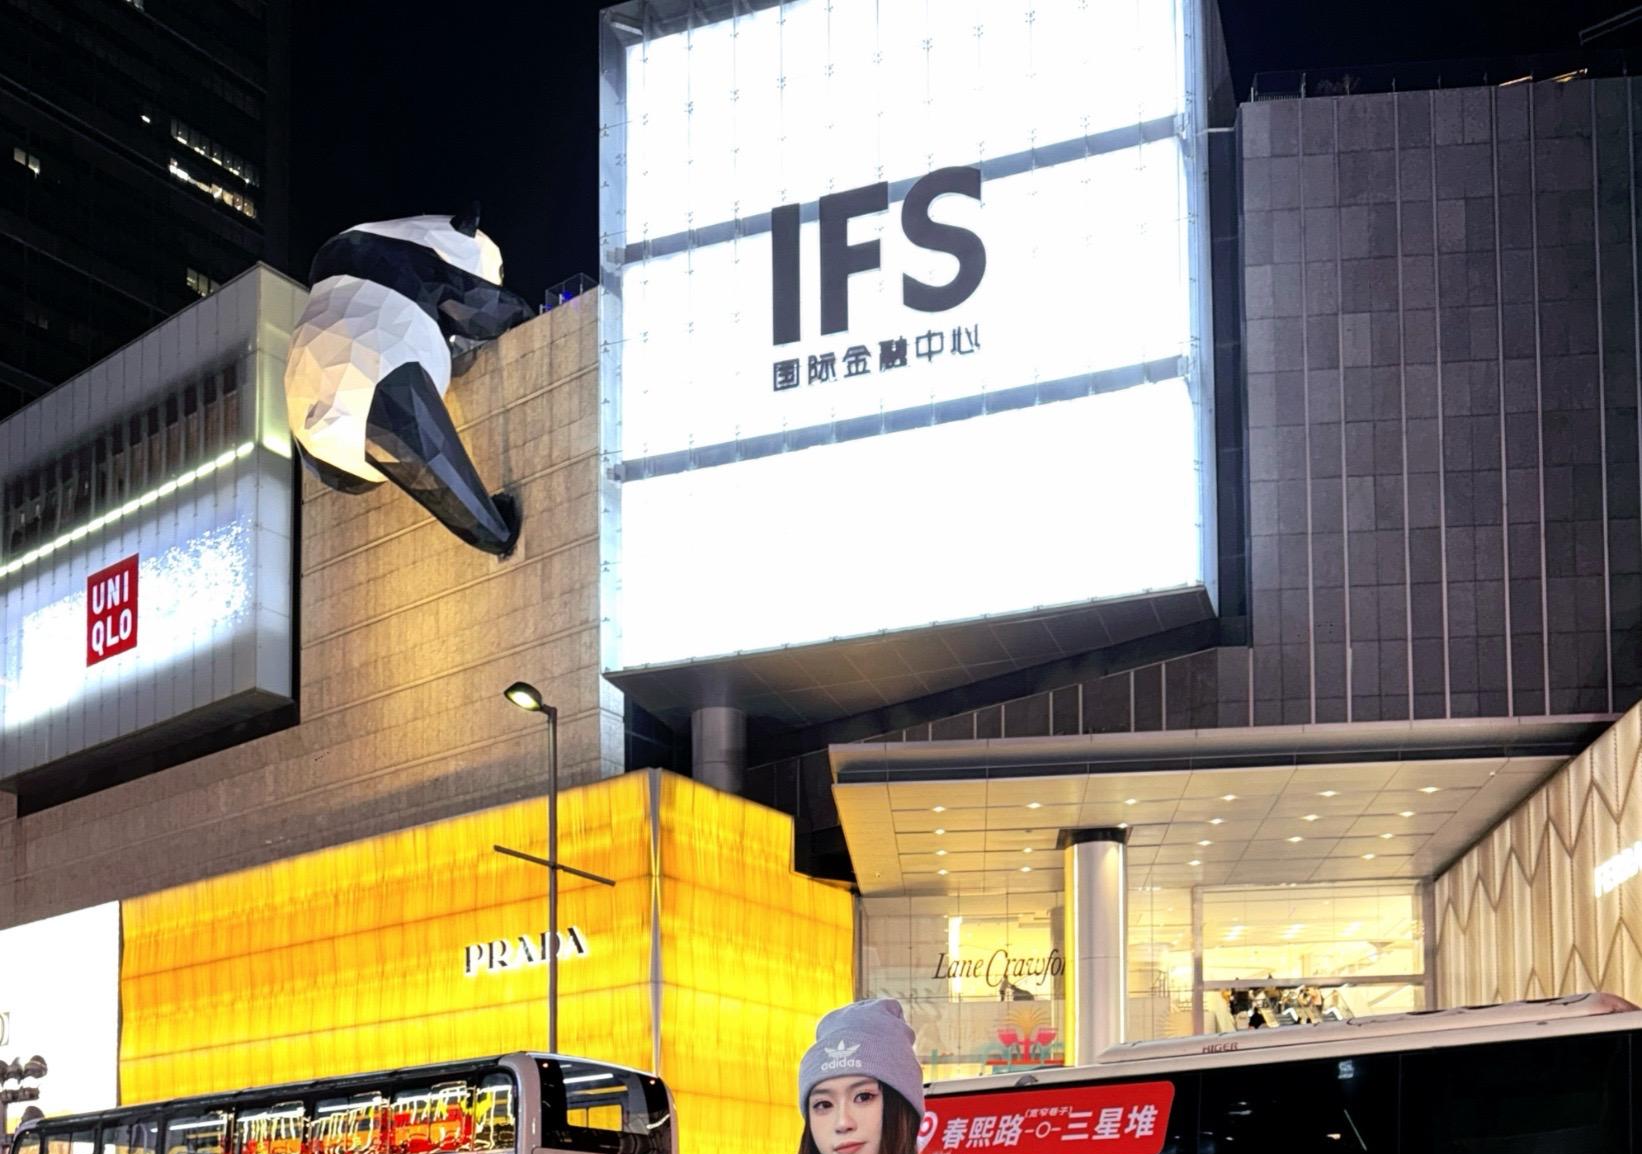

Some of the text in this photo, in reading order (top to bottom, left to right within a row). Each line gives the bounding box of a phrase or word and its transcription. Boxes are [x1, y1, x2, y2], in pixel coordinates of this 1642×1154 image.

[771, 165, 987, 346] IFS
[772, 323, 982, 392] 国际金融中心
[92, 570, 129, 615] UNI
[91, 608, 132, 656] QLO
[464, 926, 585, 974] PRADA
[931, 952, 984, 979] Lane
[820, 1056, 862, 1071] adidas
[941, 1104, 1159, 1150] 春熙路 三星堆
